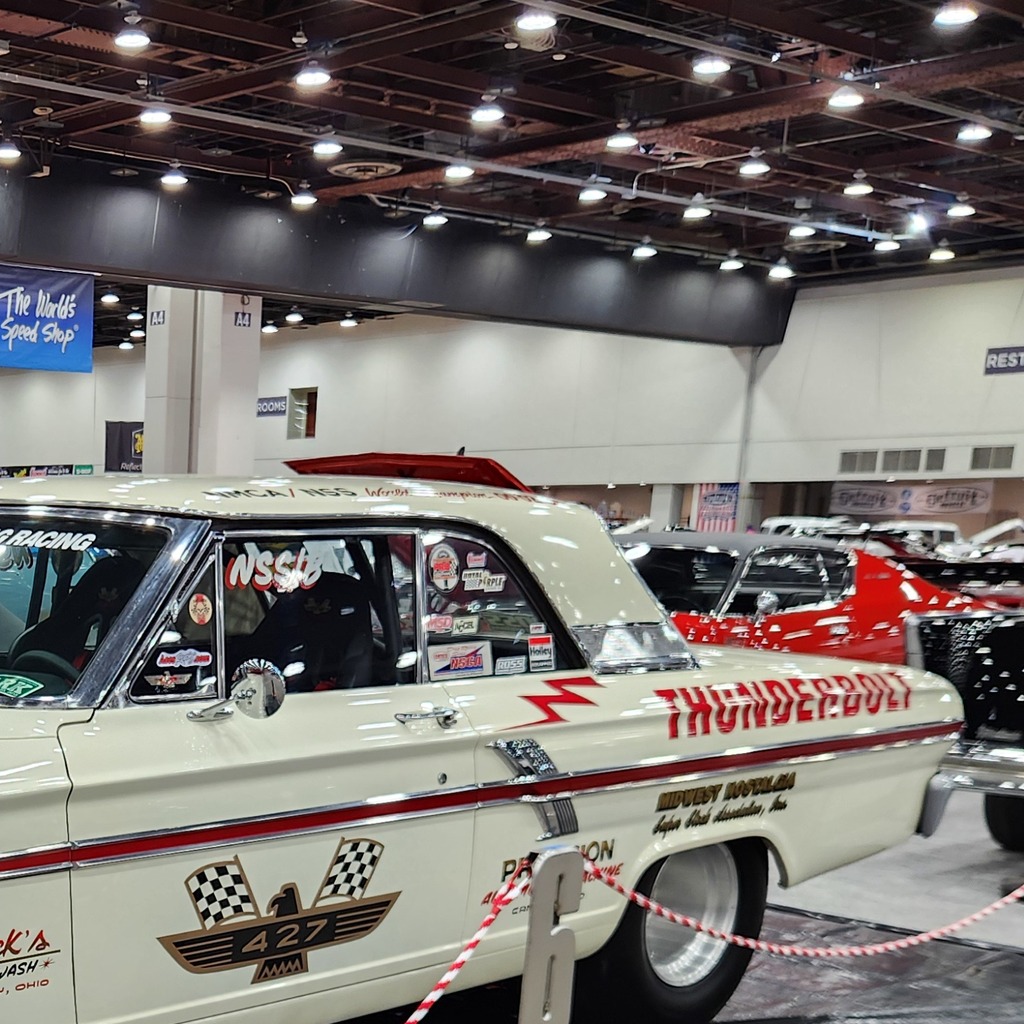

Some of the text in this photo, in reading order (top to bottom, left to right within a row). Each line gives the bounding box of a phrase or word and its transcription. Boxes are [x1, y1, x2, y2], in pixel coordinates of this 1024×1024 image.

[35, 289, 77, 319] World's
[151, 311, 164, 325] A4
[236, 313, 250, 327] A4
[0, 318, 75, 354] Speed Shop
[986, 352, 1024, 369] REST
[257, 401, 286, 413] ROOMS
[10, 529, 96, 552] RACING
[530, 646, 551, 658] Holley
[497, 660, 524, 670] ROSS
[654, 672, 912, 740] THUNDERBOLT
[656, 772, 797, 812] MIDWEST NOSTALGIA
[241, 918, 332, 954] 427
[15, 979, 50, 992] OHIO
